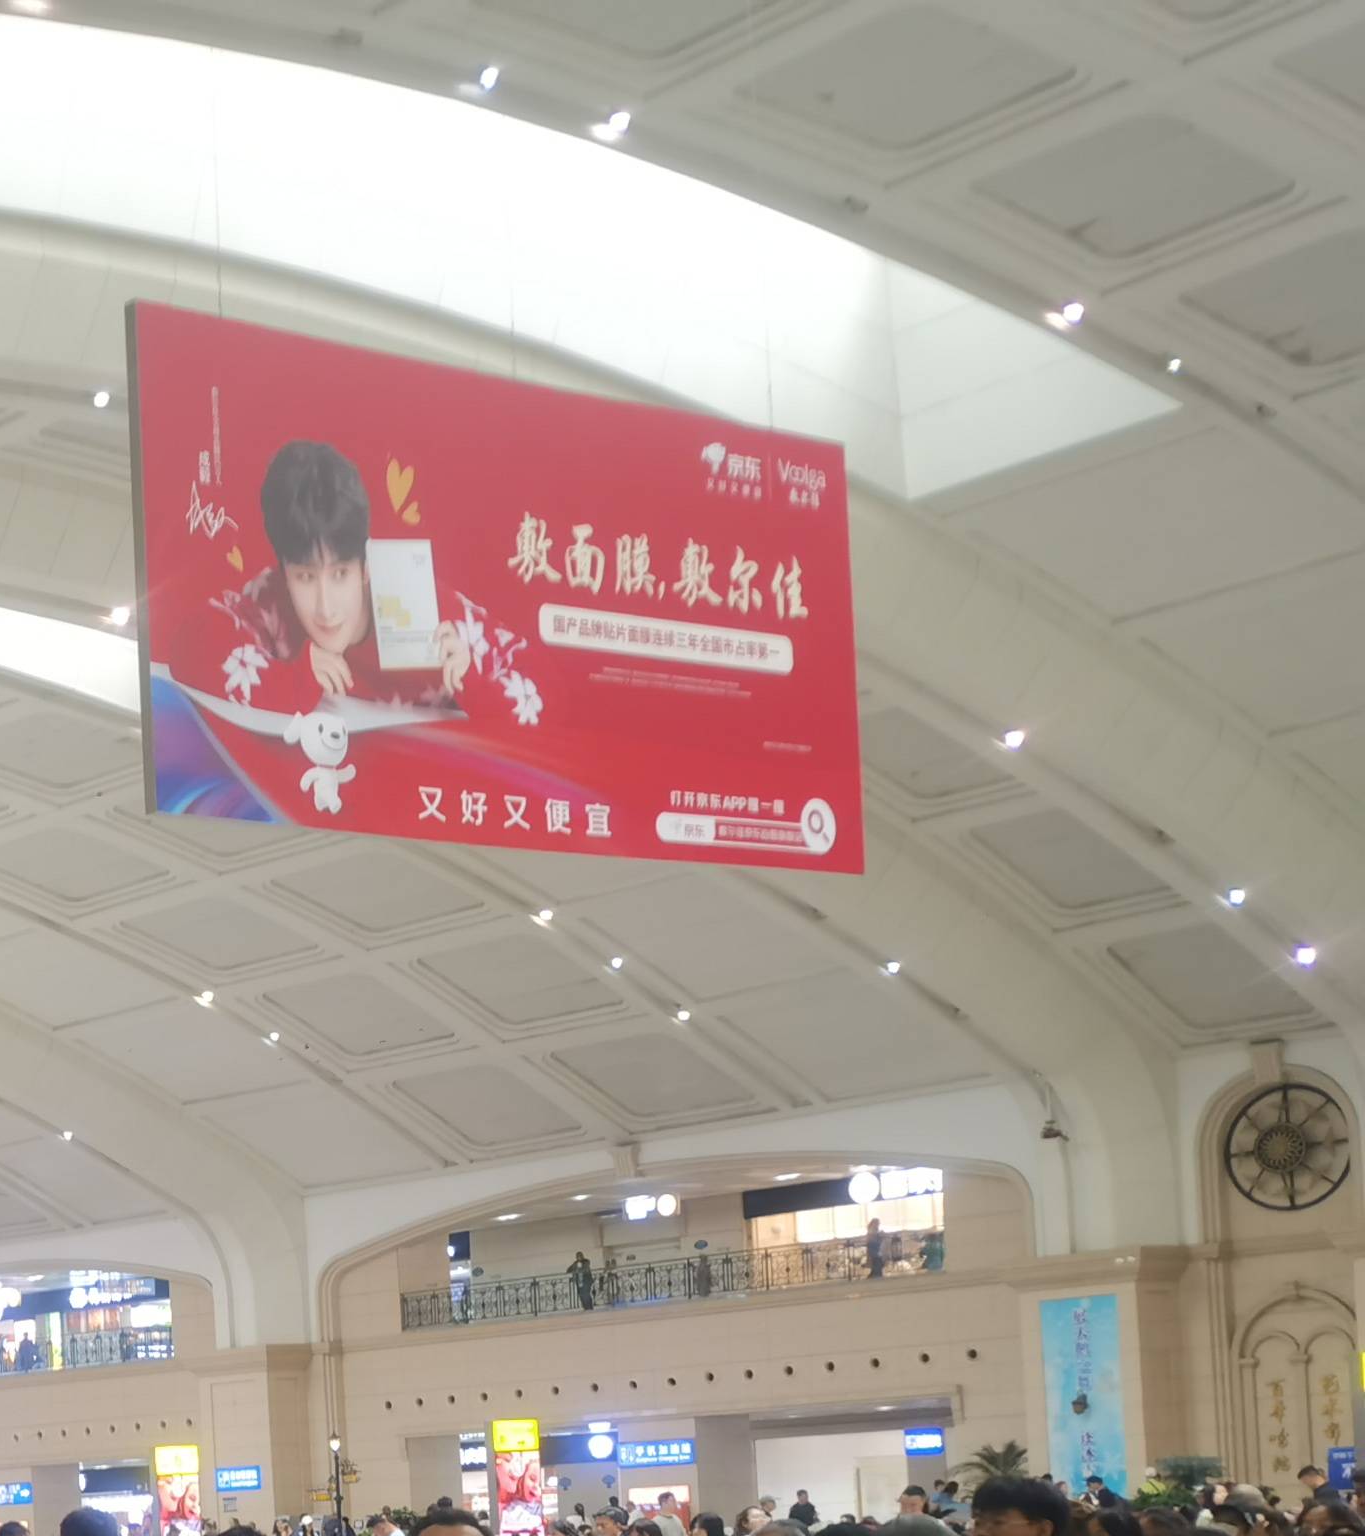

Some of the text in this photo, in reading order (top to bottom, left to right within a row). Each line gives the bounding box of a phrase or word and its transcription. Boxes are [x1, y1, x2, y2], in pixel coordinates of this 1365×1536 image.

[726, 453, 762, 481] 京东
[777, 457, 827, 489] Voolga
[418, 785, 614, 838] 又好又便宜
